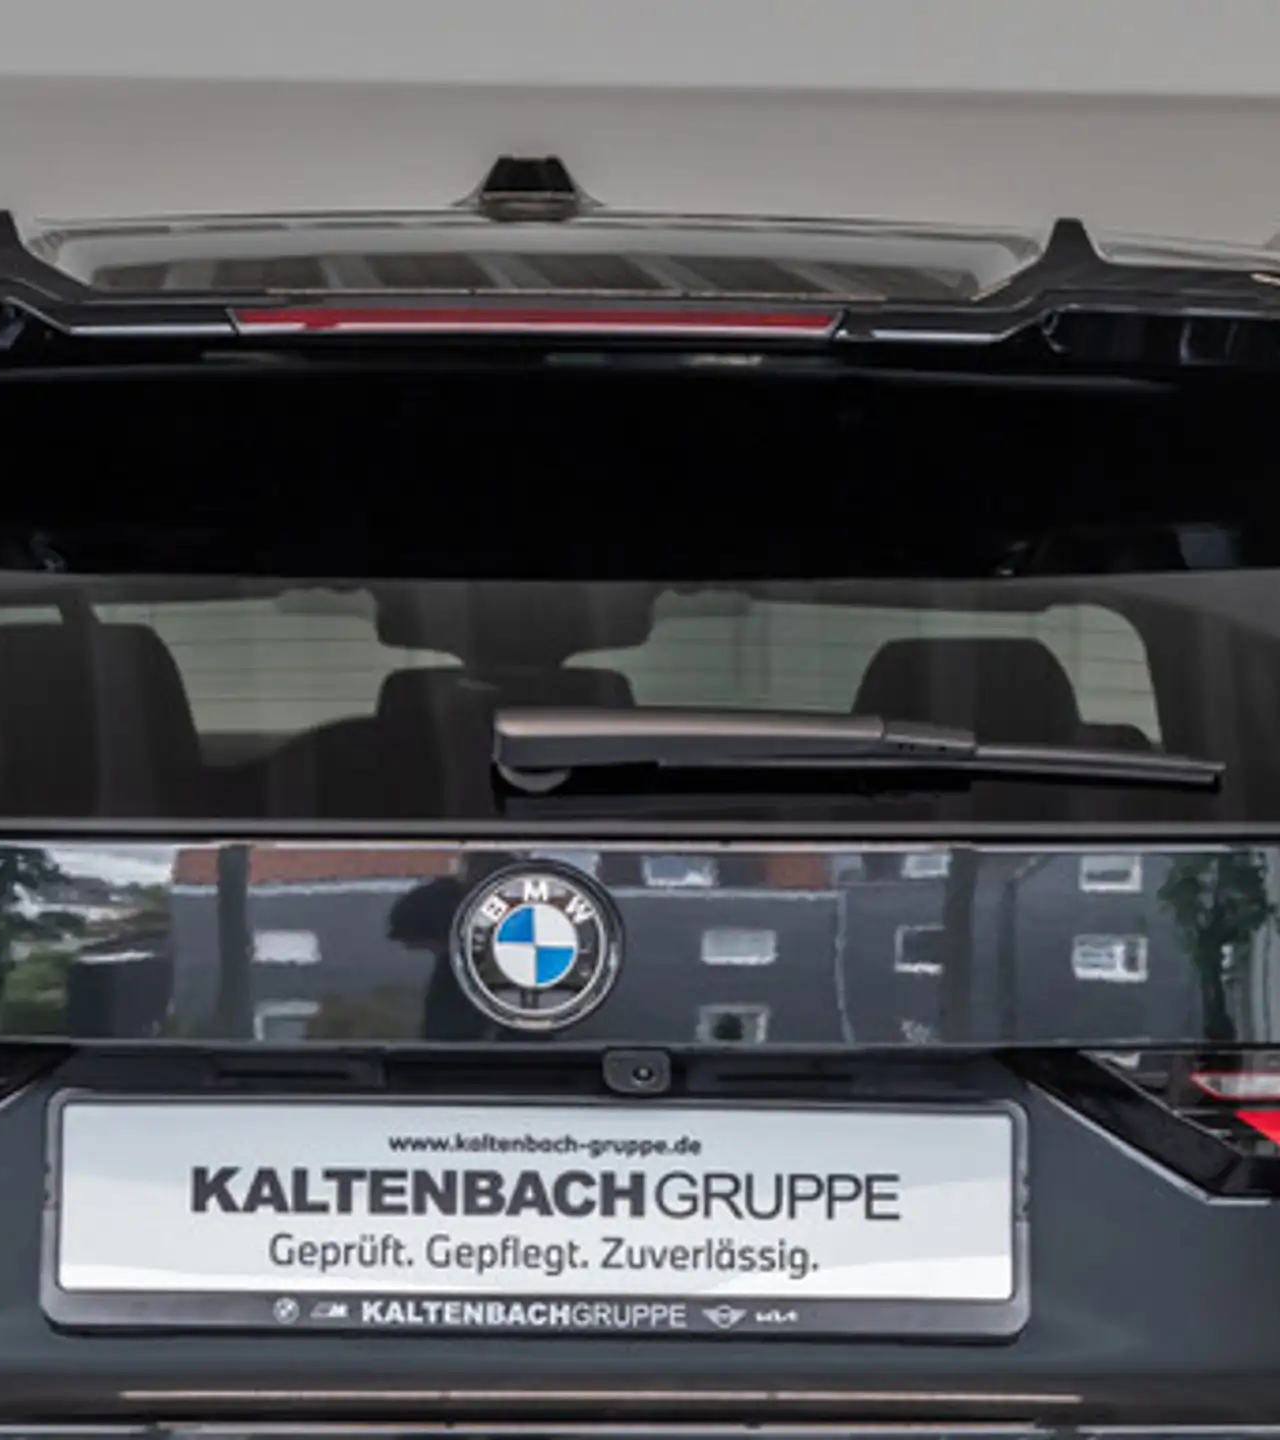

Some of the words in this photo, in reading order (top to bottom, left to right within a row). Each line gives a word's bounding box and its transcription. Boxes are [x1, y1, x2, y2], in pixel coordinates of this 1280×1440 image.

[480, 880, 595, 924] BMW
[388, 1132, 702, 1158] www.kaltenbach-gruppe.de
[269, 1232, 413, 1273] Geprüft.
[425, 1233, 589, 1277] Gepflegt.
[600, 1236, 819, 1280] Zuverlässig.
